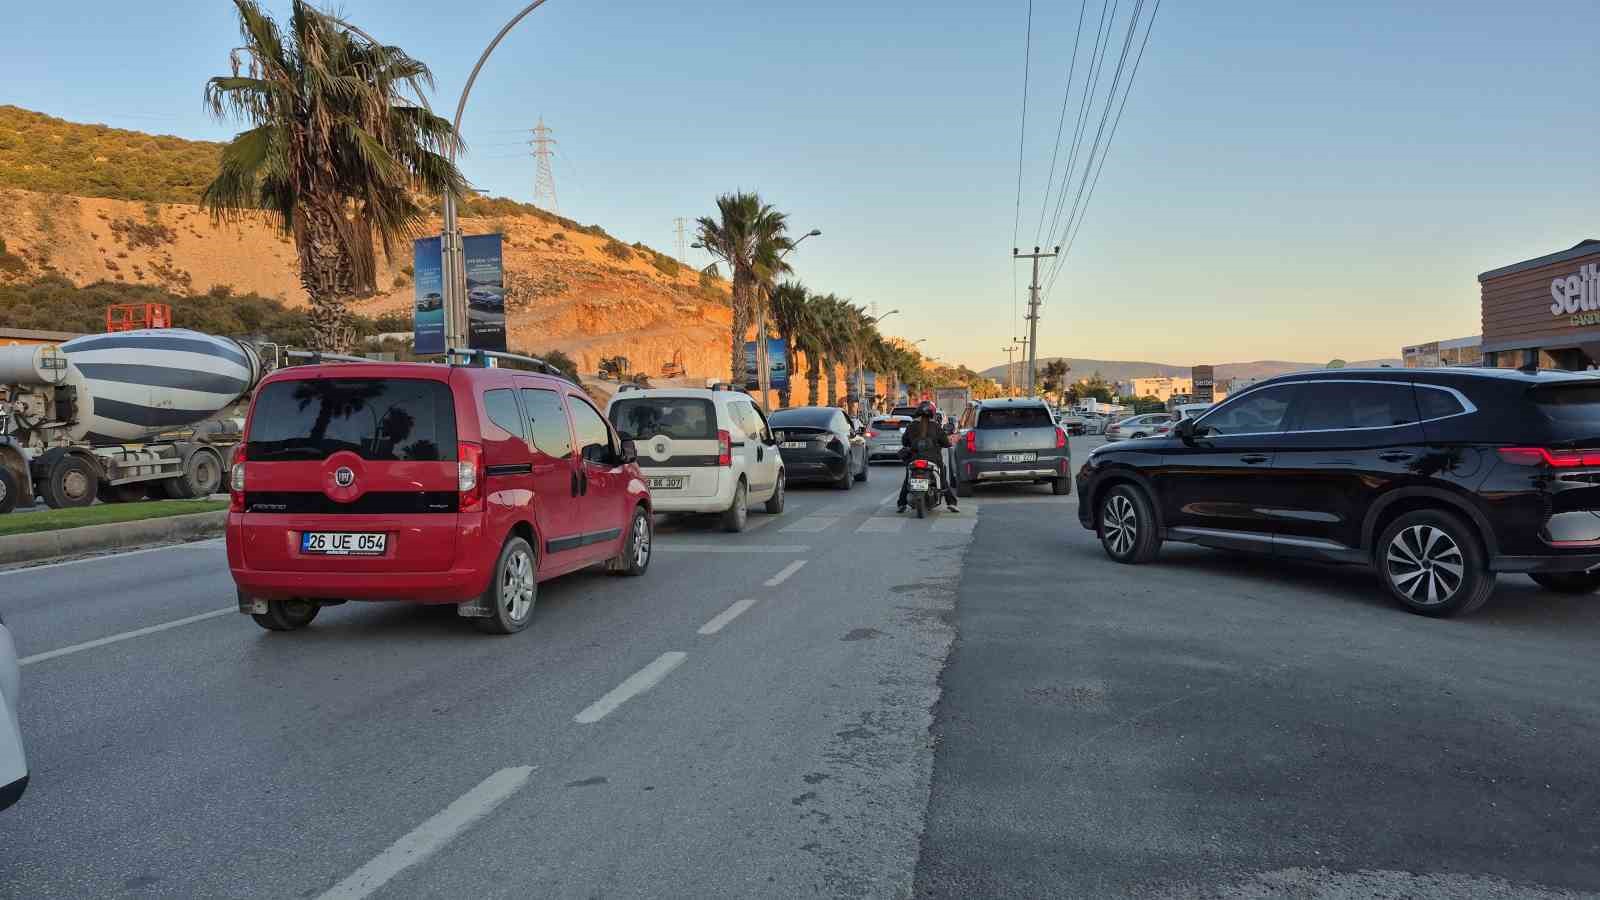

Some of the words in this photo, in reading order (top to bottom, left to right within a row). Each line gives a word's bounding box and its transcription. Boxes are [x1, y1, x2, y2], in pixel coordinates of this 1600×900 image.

[309, 535, 326, 549] 26
[332, 536, 352, 549] UE
[358, 536, 383, 549] 054
